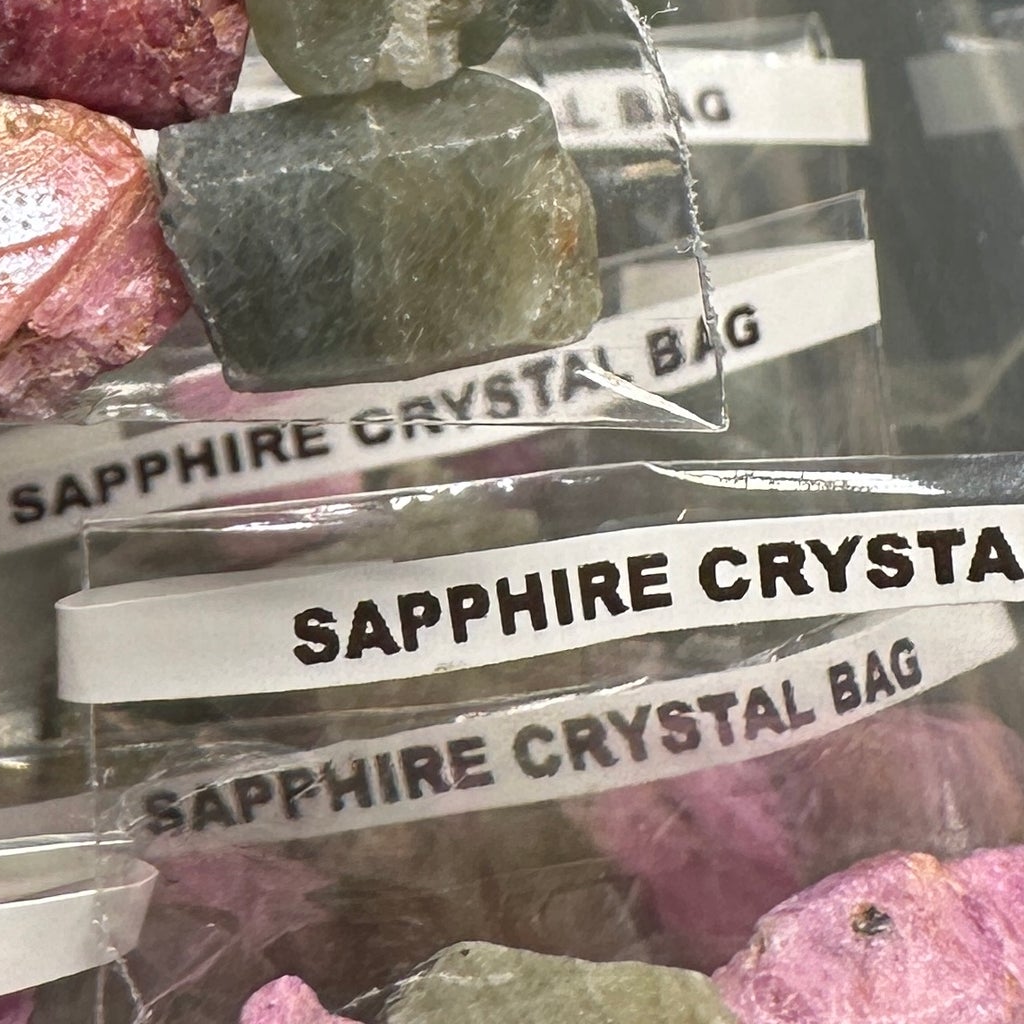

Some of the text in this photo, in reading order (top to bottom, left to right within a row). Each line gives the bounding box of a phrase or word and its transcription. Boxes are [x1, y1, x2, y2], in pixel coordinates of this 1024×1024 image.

[9, 304, 761, 525] SAPPHIRE CRYSTAL BAG
[292, 552, 673, 666] SAPPHIRE
[143, 636, 923, 837] SAPPHIRE CRYSTAL BAG
